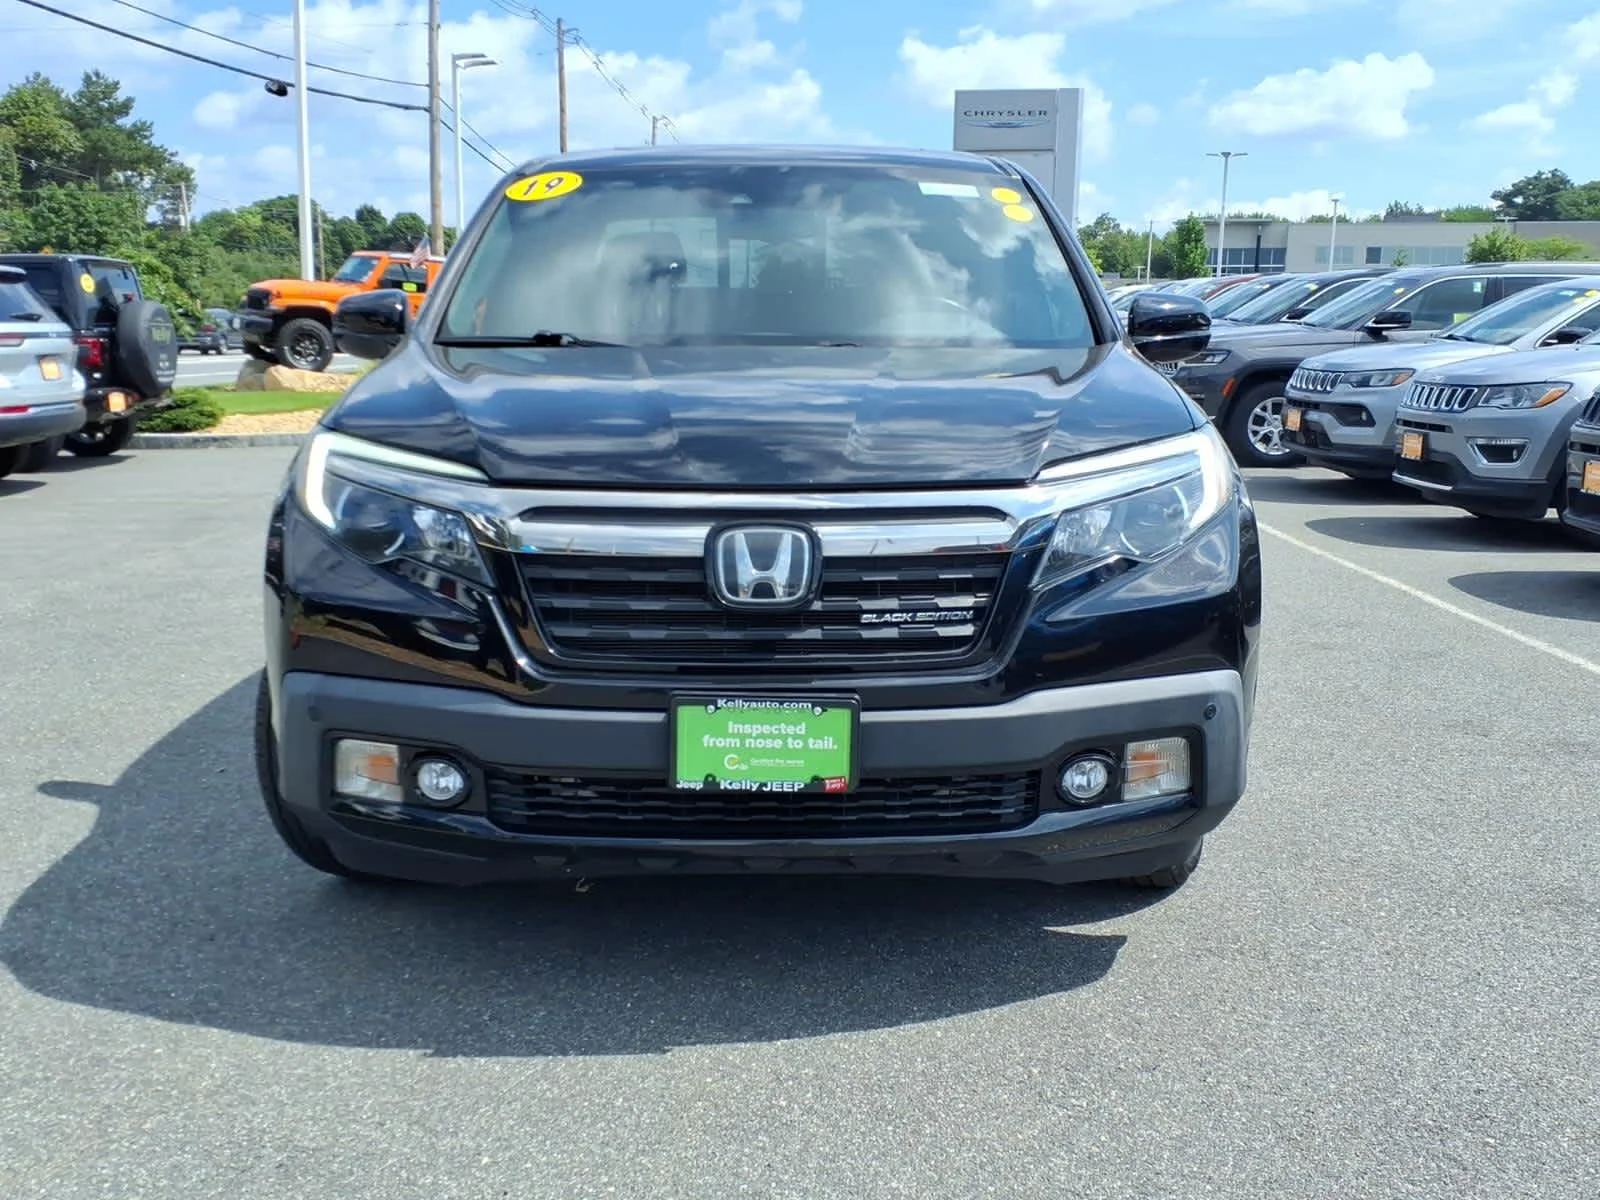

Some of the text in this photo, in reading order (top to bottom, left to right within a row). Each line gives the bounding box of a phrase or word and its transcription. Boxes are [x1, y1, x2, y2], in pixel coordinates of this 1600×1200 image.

[963, 109, 1048, 117] CHRYSLER
[860, 610, 974, 623] BLACK EDITION
[716, 699, 812, 709] Kellyauto.com
[727, 721, 806, 737] Inspected
[702, 734, 838, 750] from nose to tail.
[676, 780, 703, 791] Jeep
[719, 779, 805, 792] Kelly JEEP
